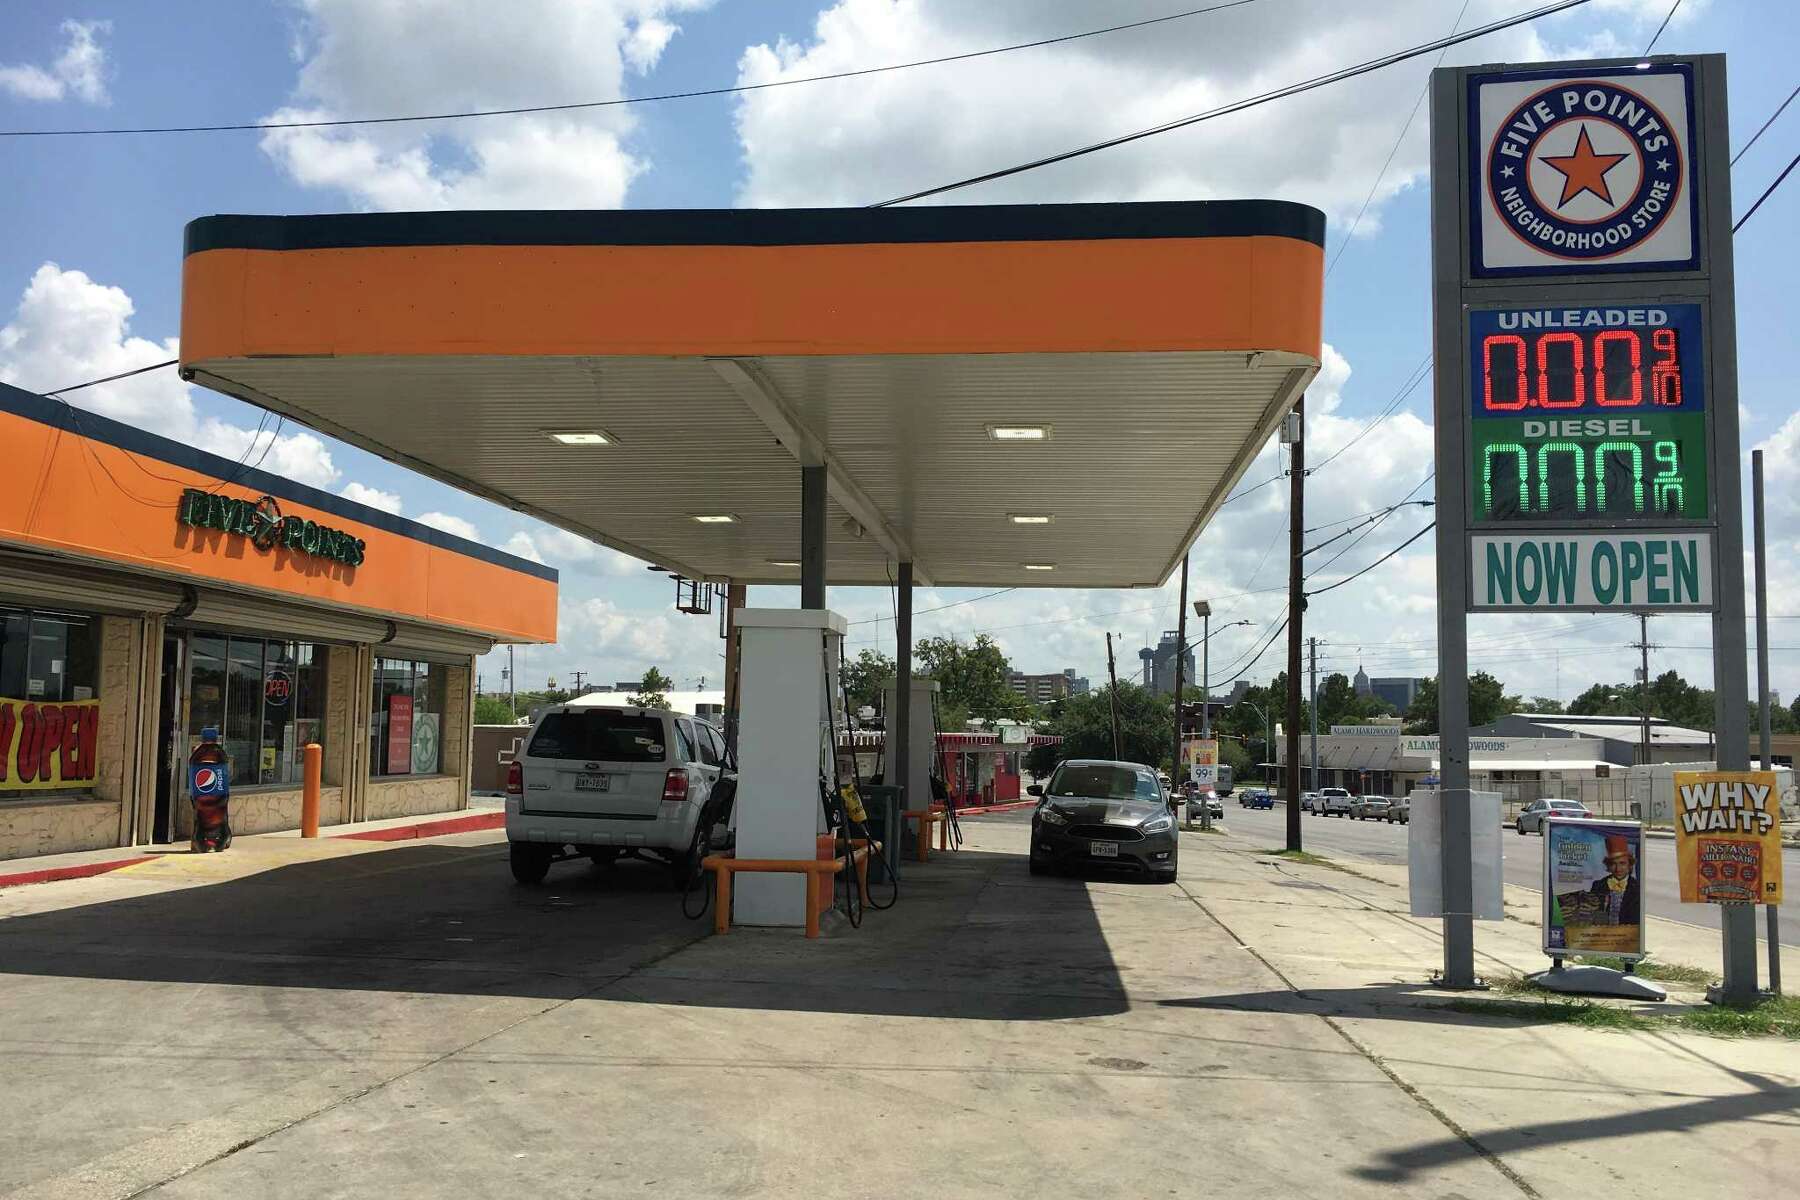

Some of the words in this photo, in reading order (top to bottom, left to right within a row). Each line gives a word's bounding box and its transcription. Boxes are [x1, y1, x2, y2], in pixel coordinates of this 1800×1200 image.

[1500, 100, 1556, 158] FIVE
[1562, 89, 1669, 152] POINTS
[1500, 185, 1632, 249] NEIGHBORHOOD
[1637, 179, 1671, 229] STORE
[1498, 309, 1668, 328] UNLEADED
[1523, 419, 1652, 438] DIESEL
[1486, 540, 1578, 605] NOW
[1590, 539, 1700, 604] OPEN
[265, 679, 290, 697] OPEN
[1333, 726, 1356, 735] ALAMO
[16, 702, 100, 784] OPEN
[1468, 741, 1505, 751] DWOODS
[216, 768, 224, 791] pepsi
[1679, 781, 1771, 812] WHY
[1680, 808, 1774, 836] WAIT?
[1706, 843, 1753, 856] INSTANT
